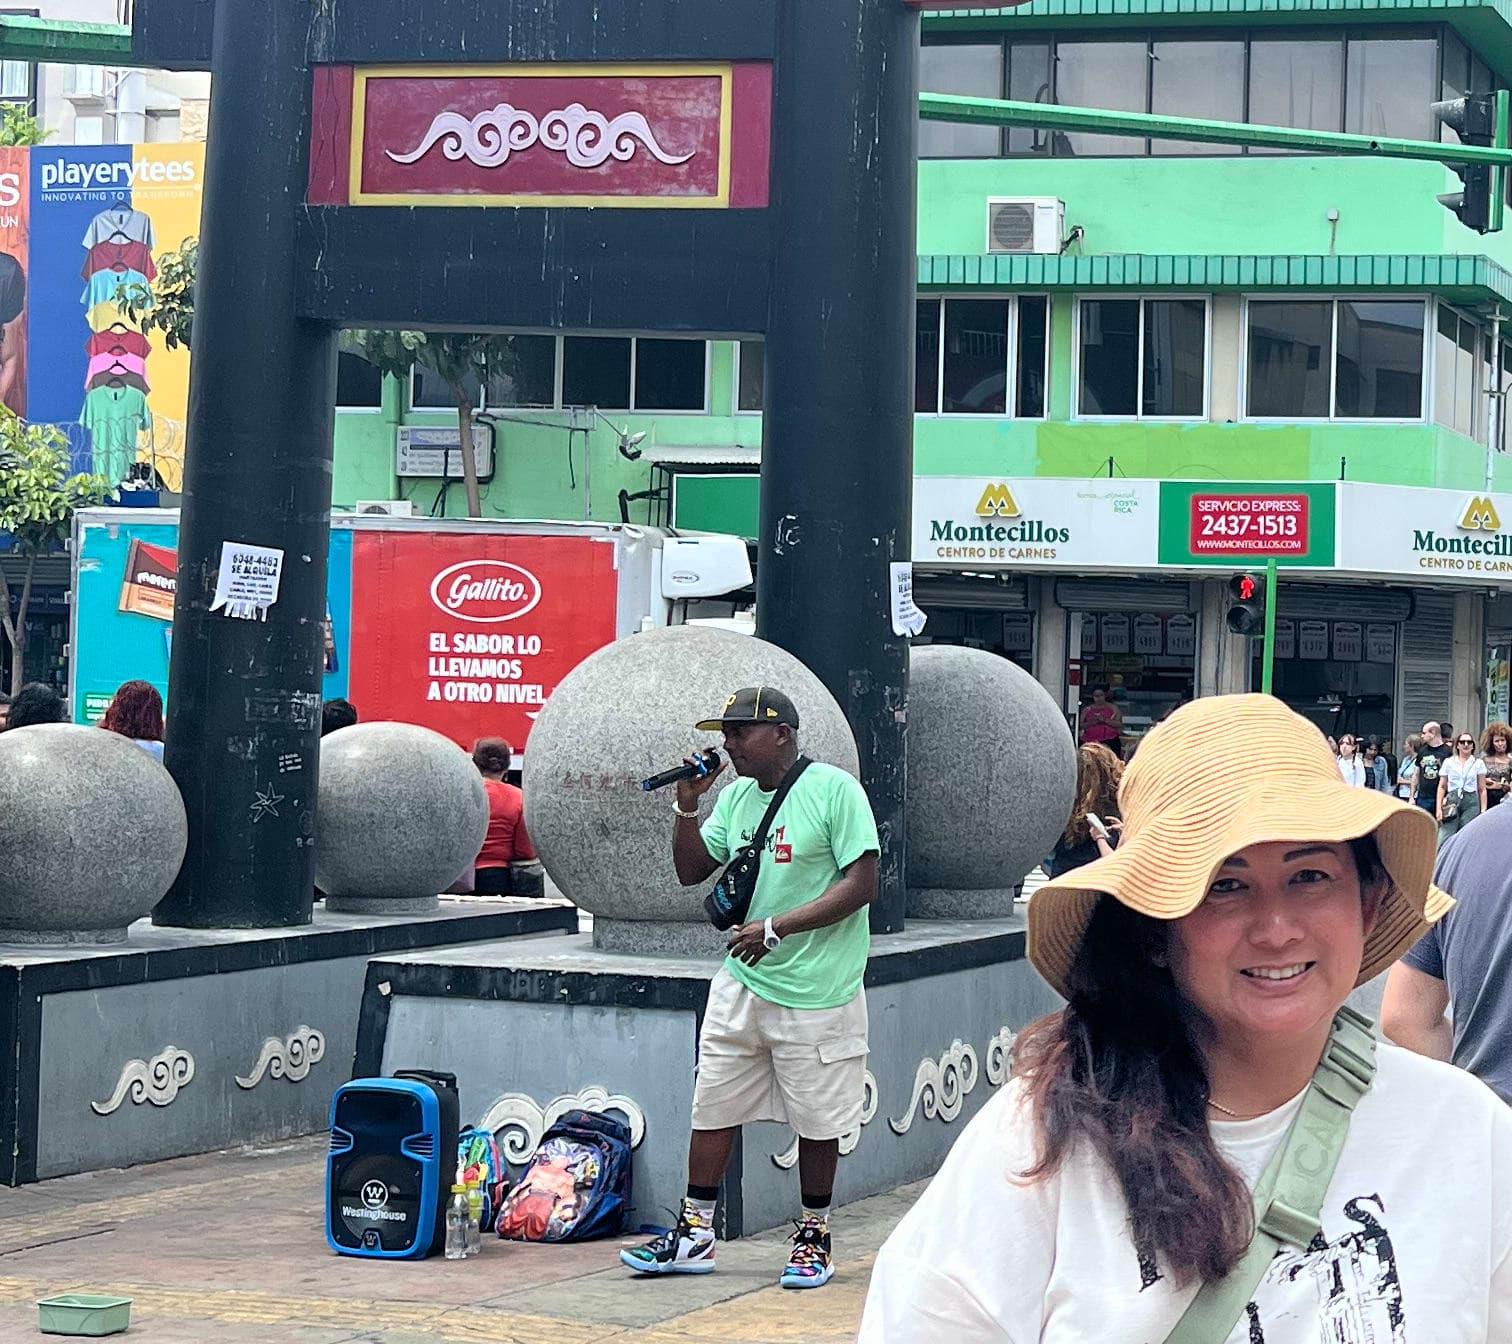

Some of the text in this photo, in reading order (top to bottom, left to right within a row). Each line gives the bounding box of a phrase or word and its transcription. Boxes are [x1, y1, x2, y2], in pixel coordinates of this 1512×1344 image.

[42, 158, 195, 189] playerytees
[41, 192, 107, 202] INNOVATING
[111, 192, 125, 201] TO
[1198, 500, 1302, 512] SERVICIO EXPRESS:
[930, 520, 1070, 543] Montecillos
[1201, 514, 1297, 536] 2437-1513
[937, 547, 1057, 560] CENTRO DE CARNES
[1419, 558, 1465, 570] CENTRO
[1468, 560, 1482, 571] DE
[429, 632, 542, 655] EL SABOR LO
[428, 656, 523, 679] LLEVAMOS
[427, 681, 547, 704] A OTRO NIVEL
[342, 1205, 407, 1222] Westinghouse
